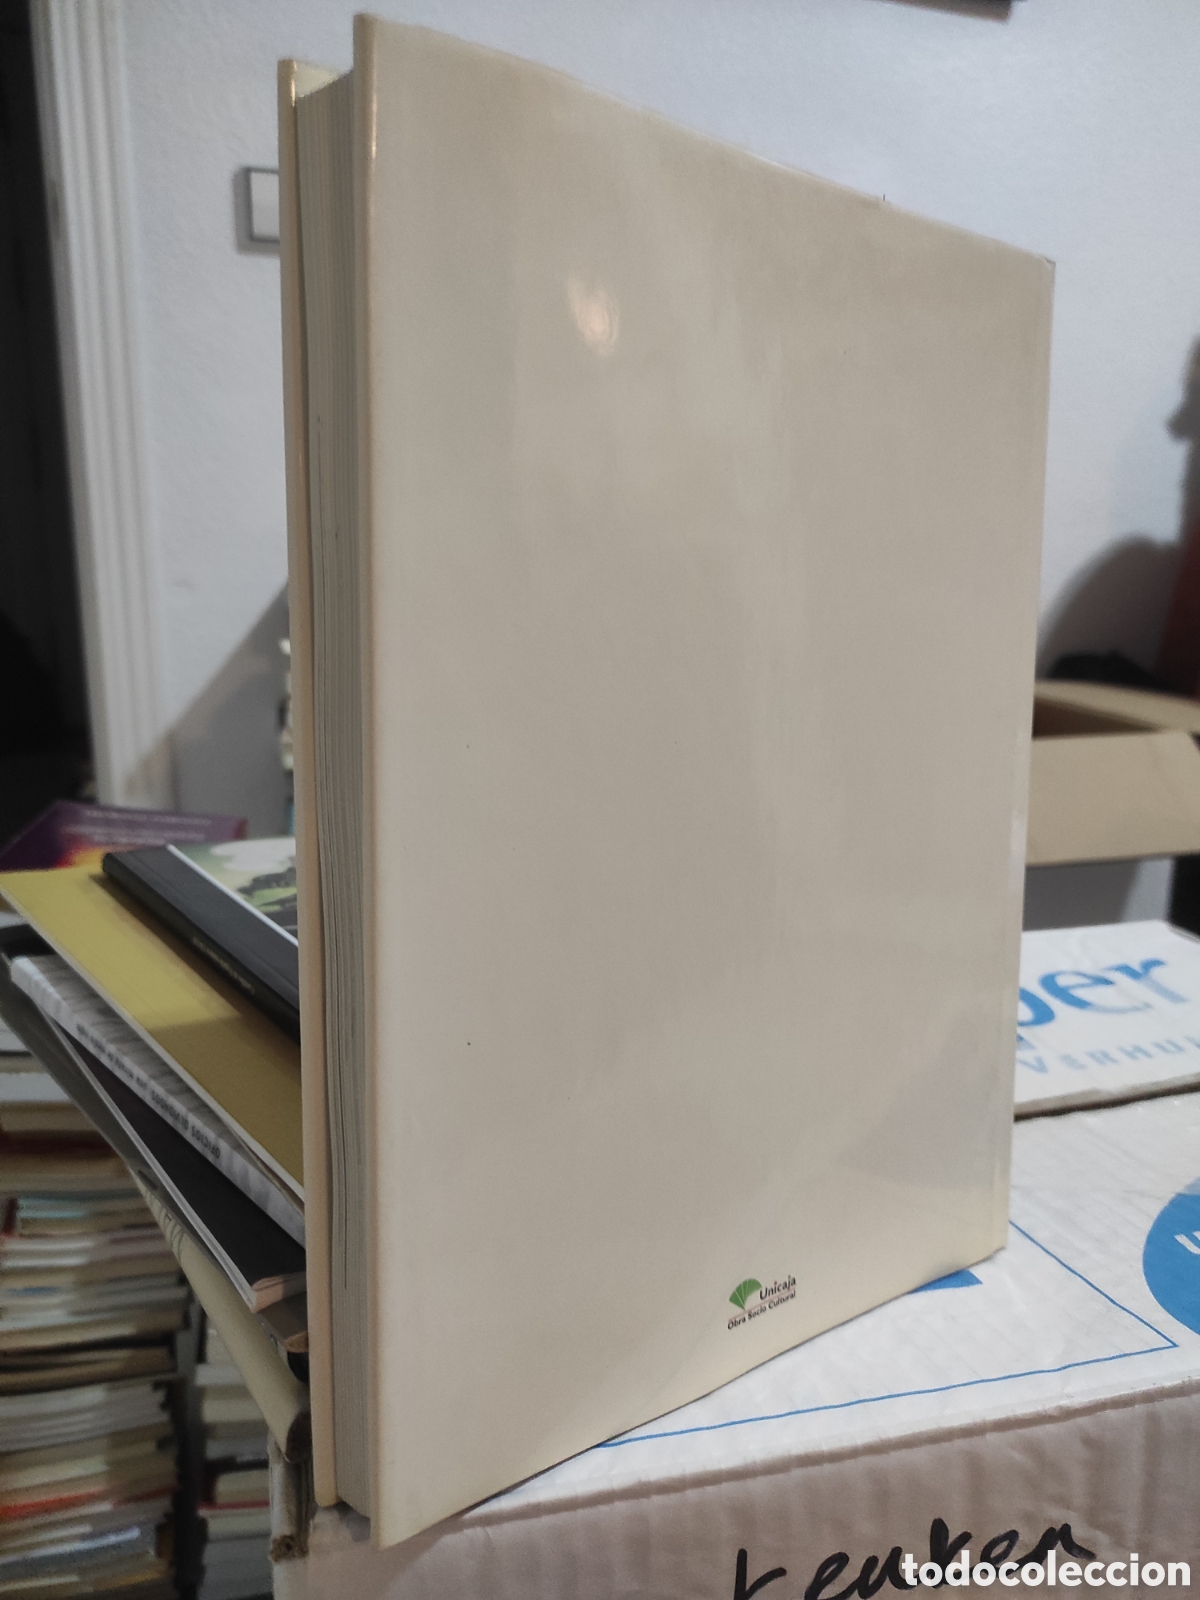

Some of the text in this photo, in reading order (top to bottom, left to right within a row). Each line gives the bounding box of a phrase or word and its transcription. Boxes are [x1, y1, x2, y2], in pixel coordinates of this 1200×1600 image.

[760, 1274, 797, 1300] Unicaja
[727, 1289, 797, 1331] Obra Socio Cultural
